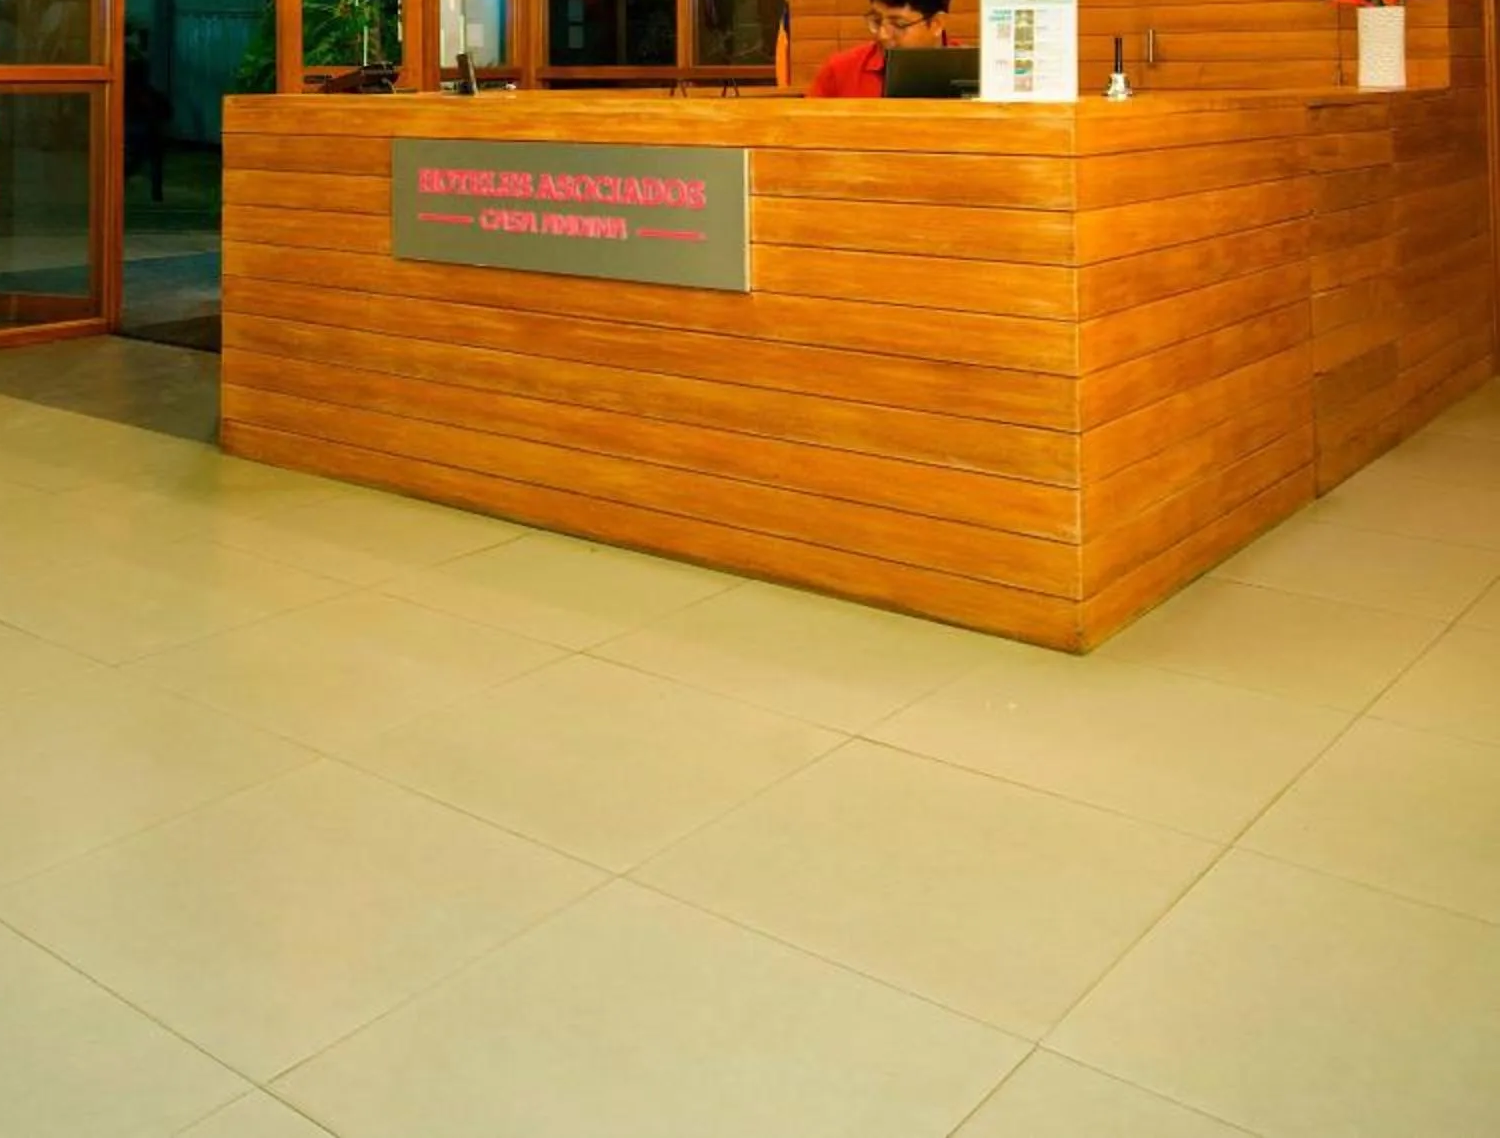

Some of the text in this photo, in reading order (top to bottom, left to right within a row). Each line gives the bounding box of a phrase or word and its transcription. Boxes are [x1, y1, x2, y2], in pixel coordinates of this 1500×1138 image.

[418, 168, 707, 210] HOTELES ASOCIADOS
[479, 208, 538, 233] CASA
